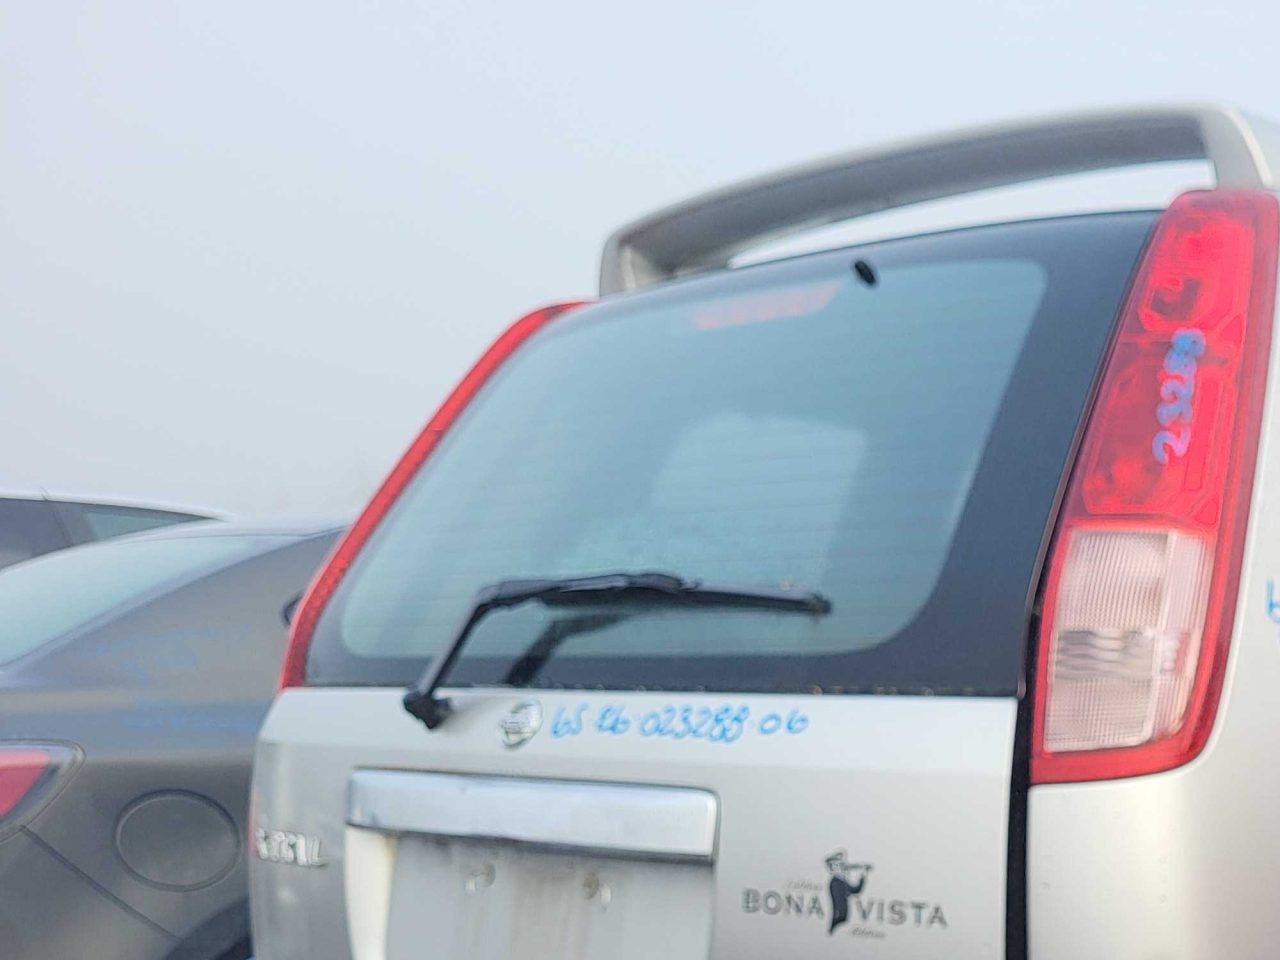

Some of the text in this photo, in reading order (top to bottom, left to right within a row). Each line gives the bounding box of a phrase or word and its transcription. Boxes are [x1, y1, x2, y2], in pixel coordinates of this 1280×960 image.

[639, 704, 750, 743] 023288
[741, 887, 949, 928] BONA VISTA
